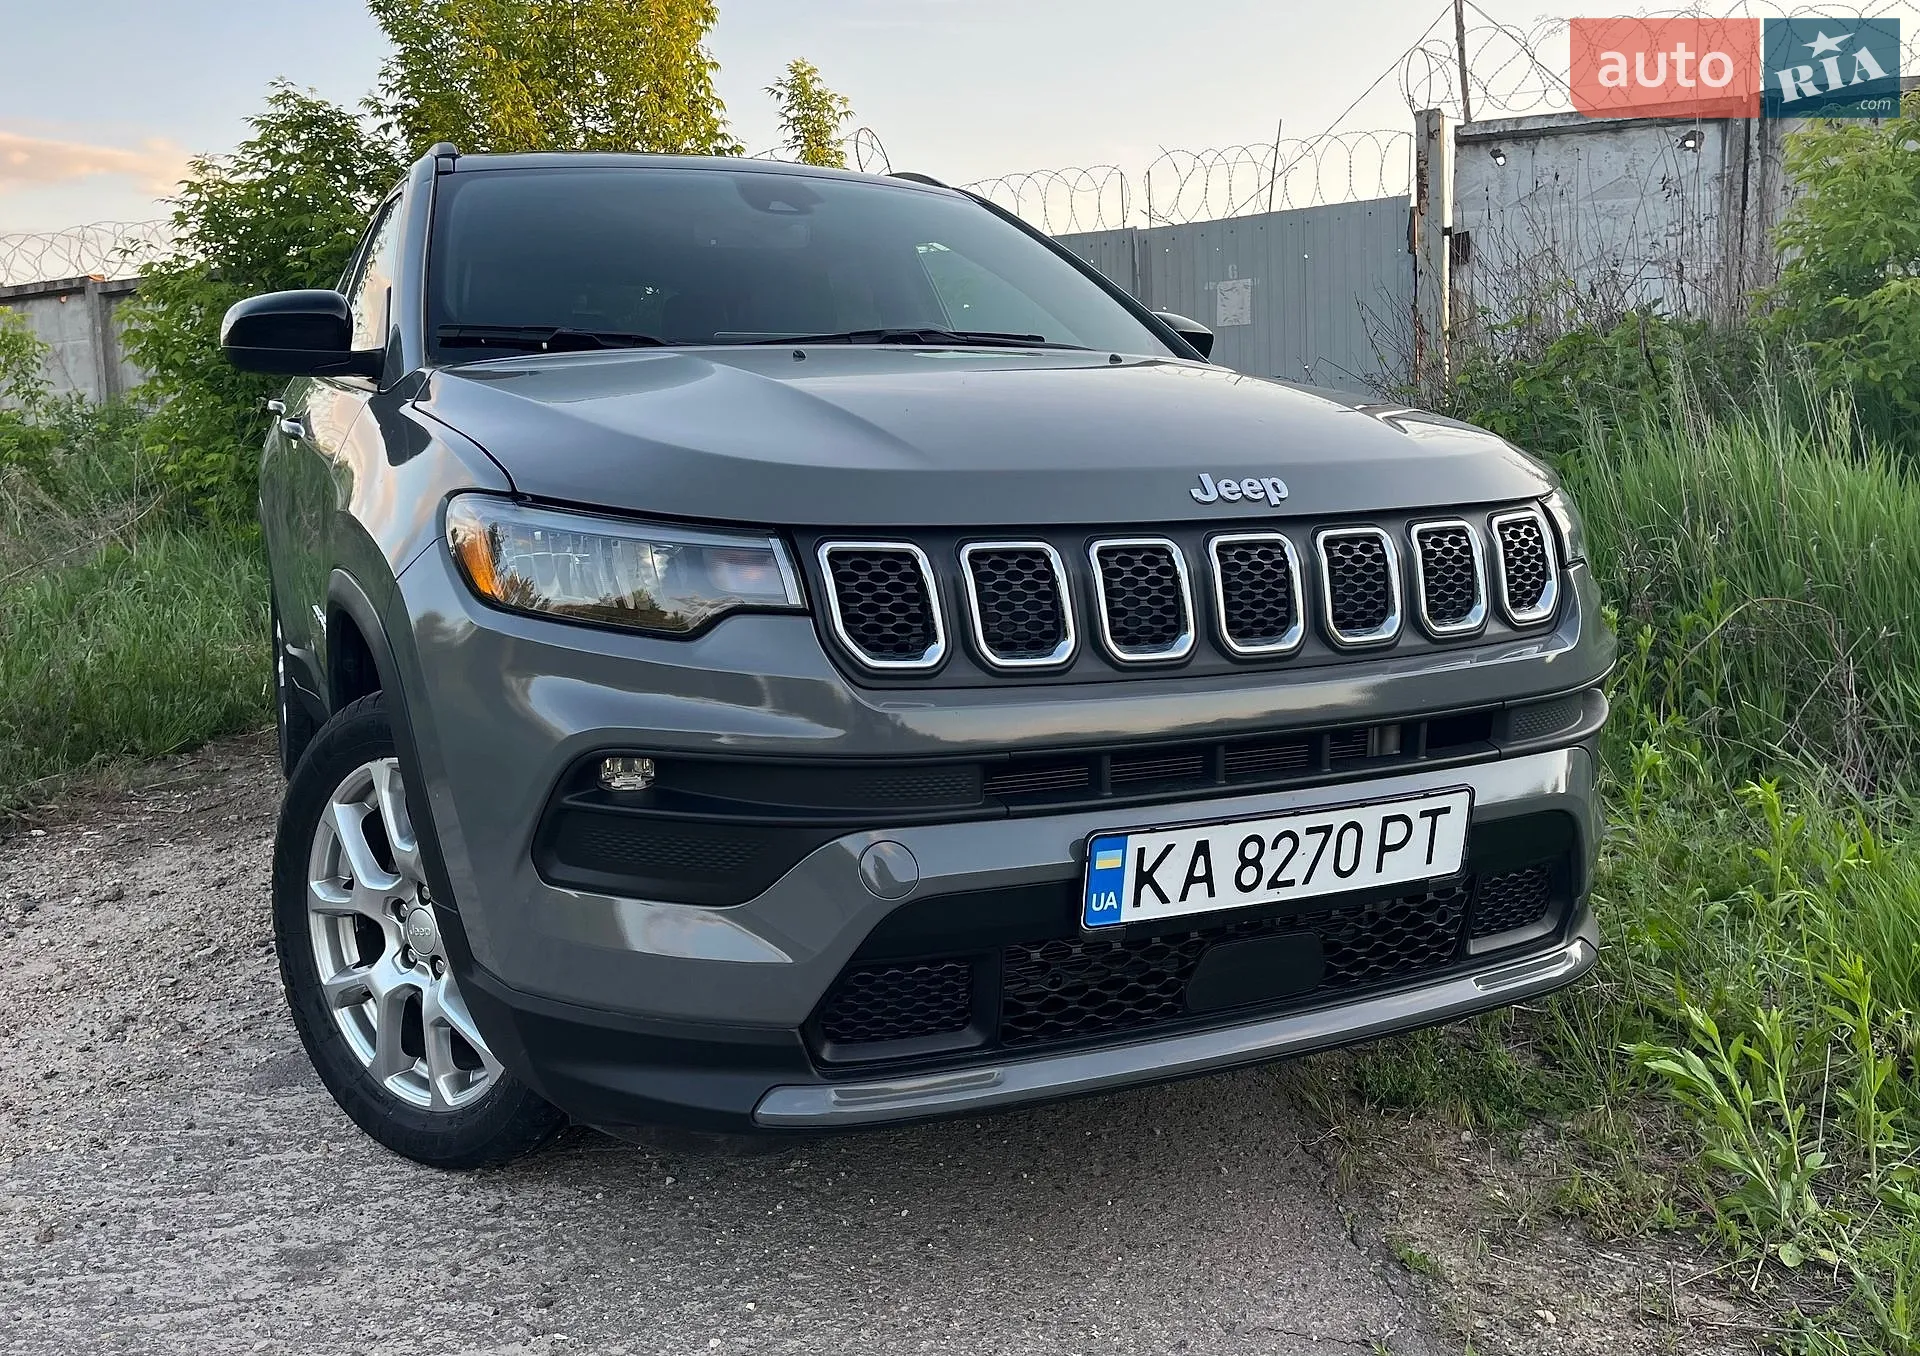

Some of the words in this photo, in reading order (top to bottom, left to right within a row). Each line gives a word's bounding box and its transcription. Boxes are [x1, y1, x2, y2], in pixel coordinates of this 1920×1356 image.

[1190, 472, 1289, 507] Jeep
[1132, 840, 1216, 908] KA
[1234, 821, 1364, 893] 8270
[1375, 806, 1451, 873] PT
[1091, 892, 1118, 912] UA
[409, 924, 431, 936] Jeep
